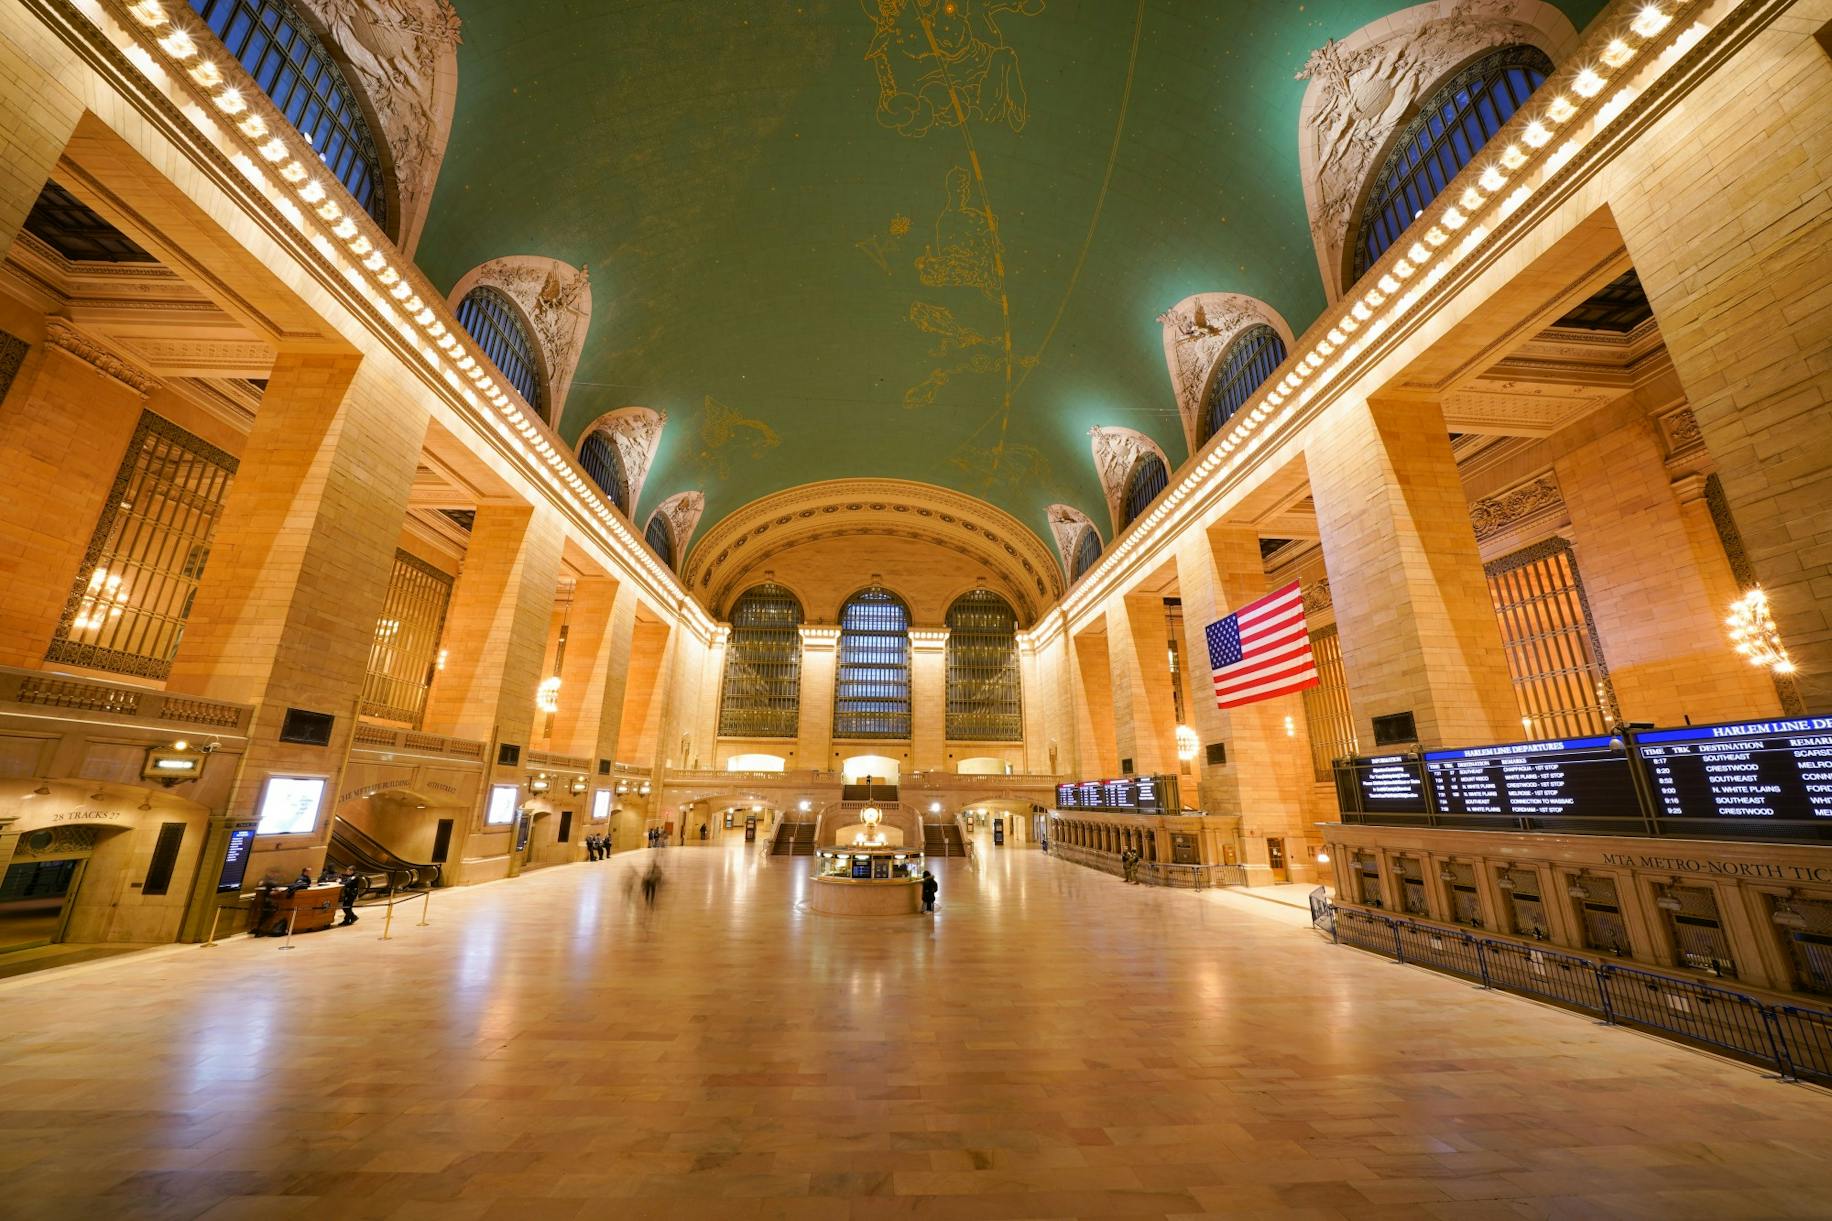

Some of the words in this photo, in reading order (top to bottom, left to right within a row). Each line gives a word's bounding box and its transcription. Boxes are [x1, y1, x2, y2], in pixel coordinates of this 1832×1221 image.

[1712, 723, 1771, 737] HARLEM
[1772, 720, 1810, 733] LINE
[1464, 747, 1493, 757] HARLEM
[1493, 746, 1511, 755] LINE
[1512, 742, 1564, 753] DEPARTURES
[1672, 746, 1690, 754] TRK
[1699, 742, 1764, 752] DESTINATION
[1702, 753, 1750, 762] SOUTHEAST
[1705, 764, 1759, 773] CRESTWOOD
[1708, 775, 1758, 783] SOUTHEAST
[67, 811, 108, 820] TRACKS
[1718, 808, 1774, 816] CRESTWOOD
[1602, 853, 1636, 867] MTA
[1639, 855, 1783, 879] METRO-NORTH
